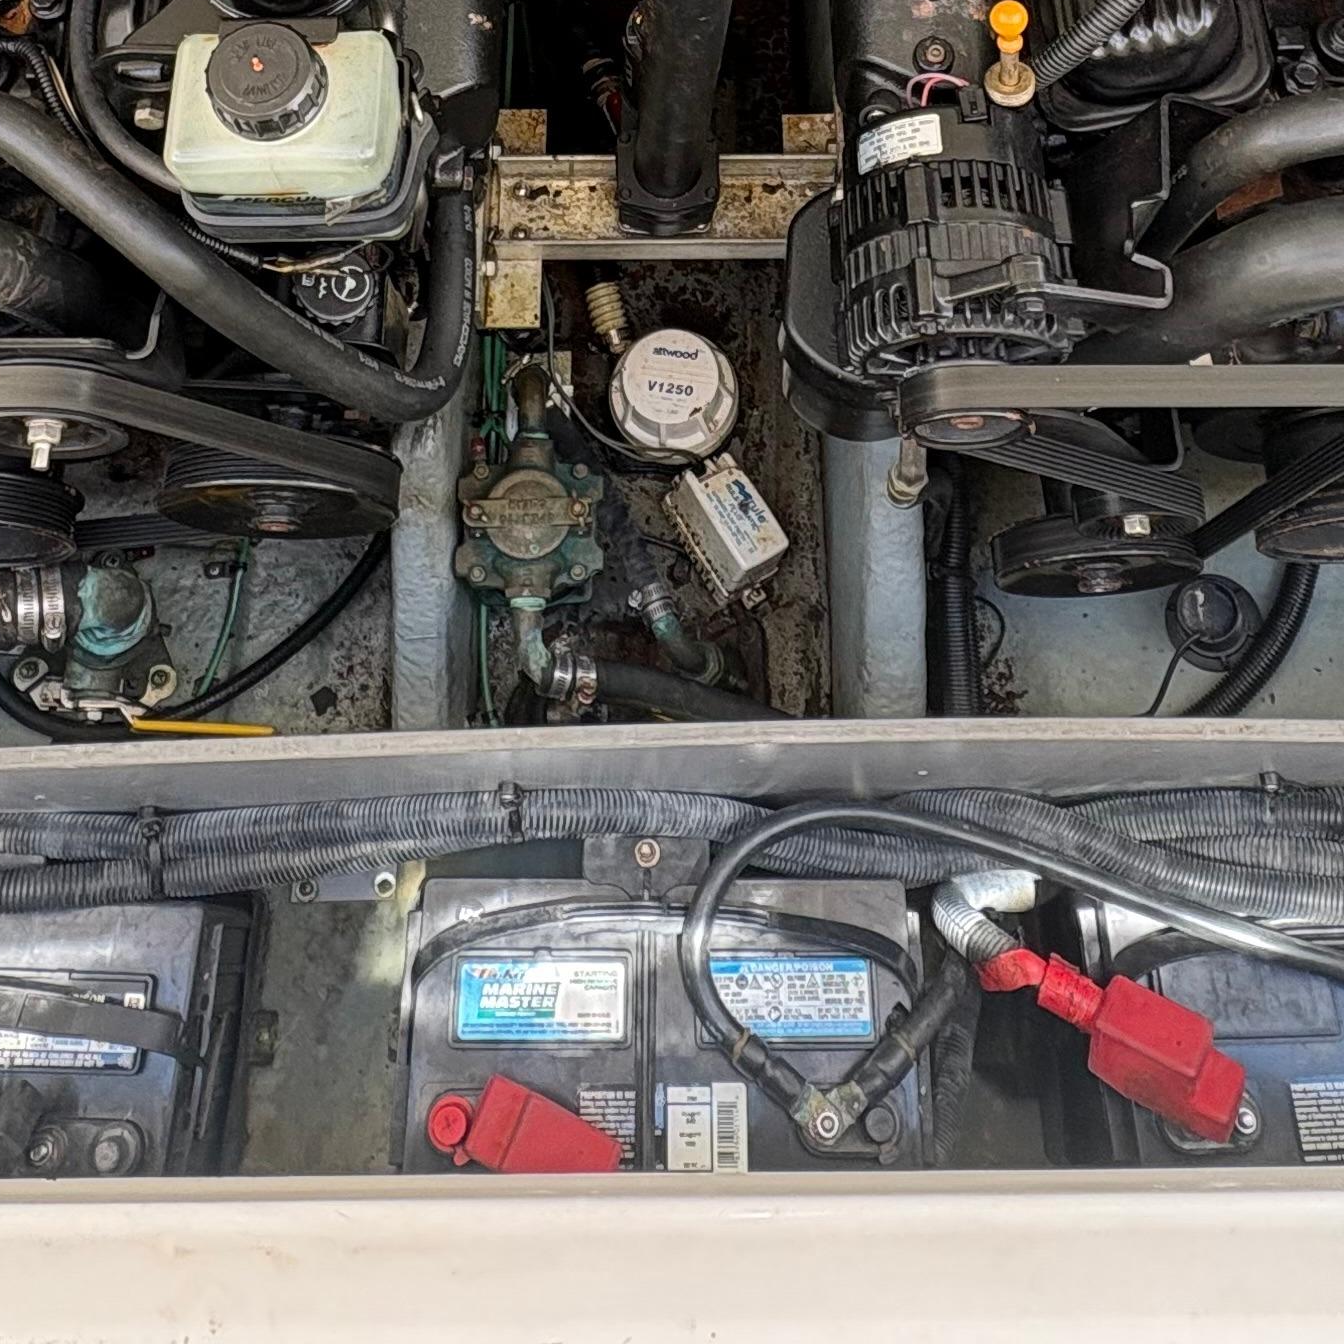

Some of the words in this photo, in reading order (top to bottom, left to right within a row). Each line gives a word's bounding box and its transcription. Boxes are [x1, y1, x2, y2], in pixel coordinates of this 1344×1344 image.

[652, 346, 699, 360] attwood
[648, 379, 694, 397] V1250
[574, 970, 618, 978] STARTING
[482, 982, 557, 996] MARINE
[480, 996, 556, 1008] MASTER
